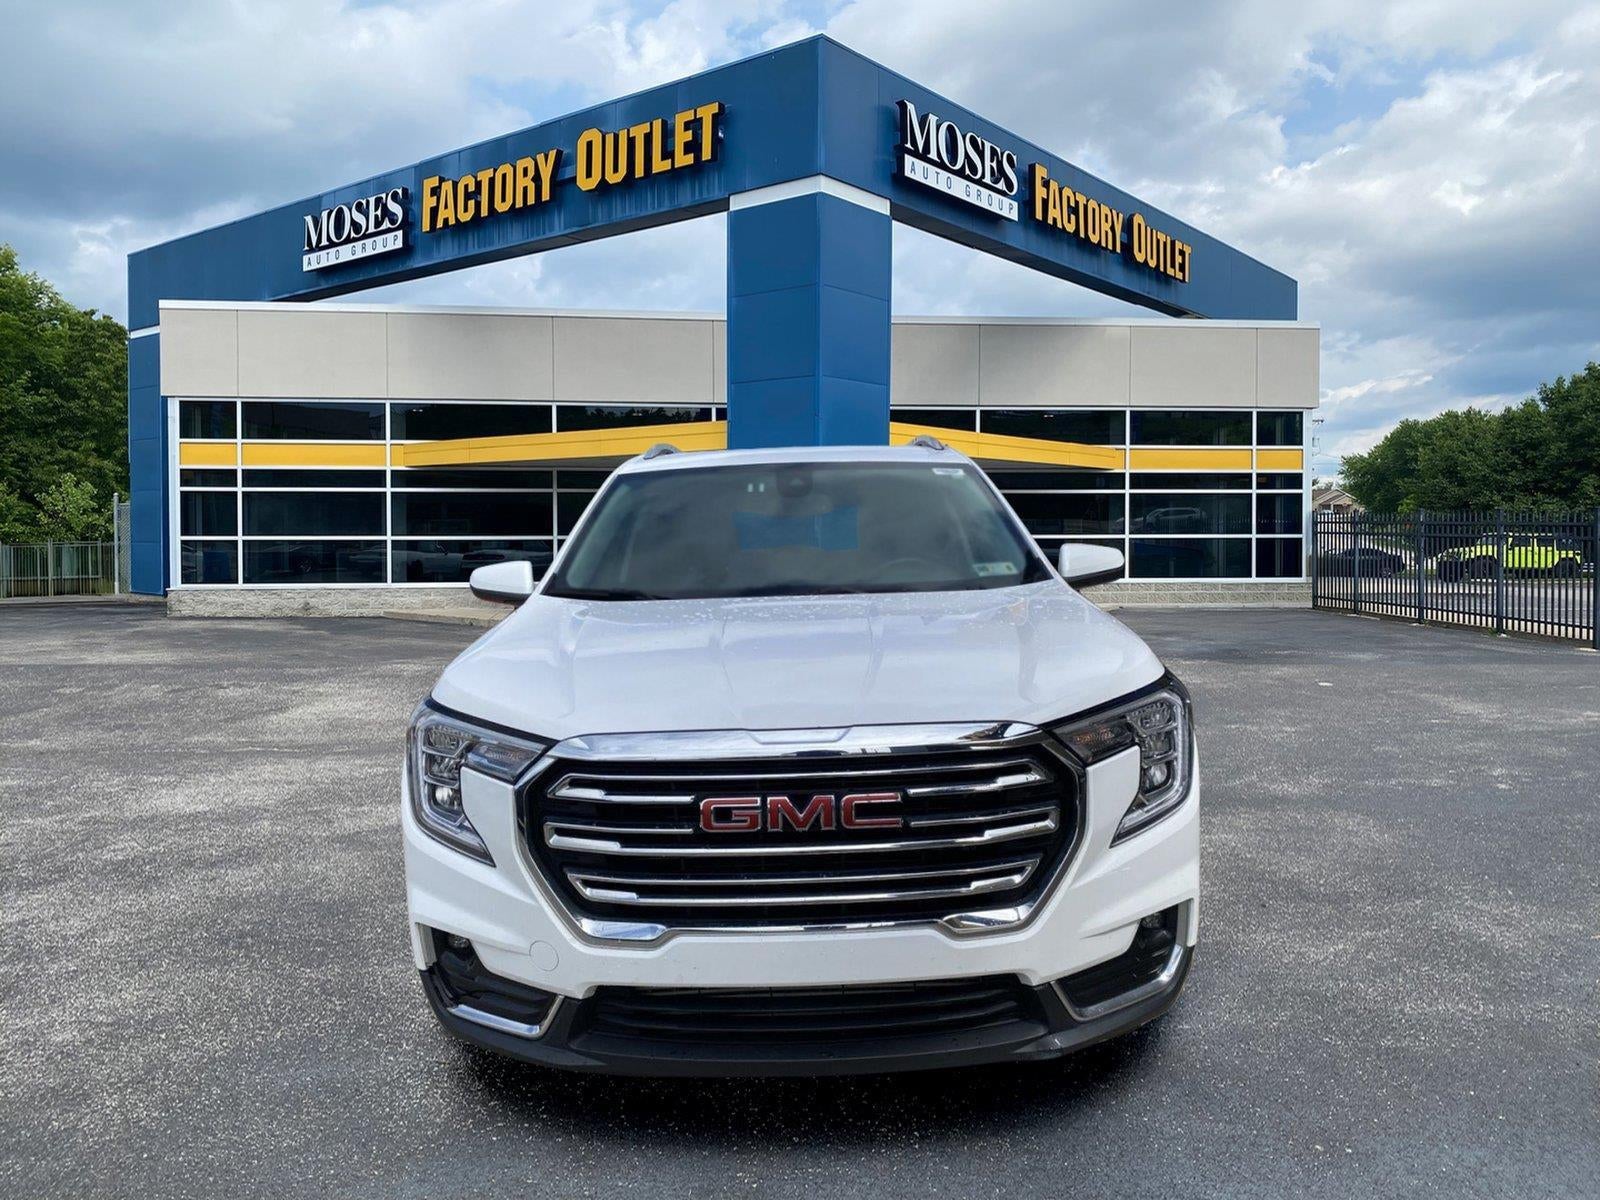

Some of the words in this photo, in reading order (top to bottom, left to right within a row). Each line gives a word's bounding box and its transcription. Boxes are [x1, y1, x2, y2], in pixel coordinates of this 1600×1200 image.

[422, 149, 559, 232] FACTORY
[577, 102, 720, 192] OUTLET
[904, 100, 1018, 195] MOSES
[303, 188, 403, 250] MOSES
[909, 161, 953, 190] AUTO
[965, 185, 1014, 215] GROUP
[307, 249, 341, 266] AUTO
[351, 235, 399, 256] GROUP
[1033, 163, 1123, 254] FACTORY
[1131, 213, 1192, 283] OUTLET
[700, 792, 902, 833] GMC
